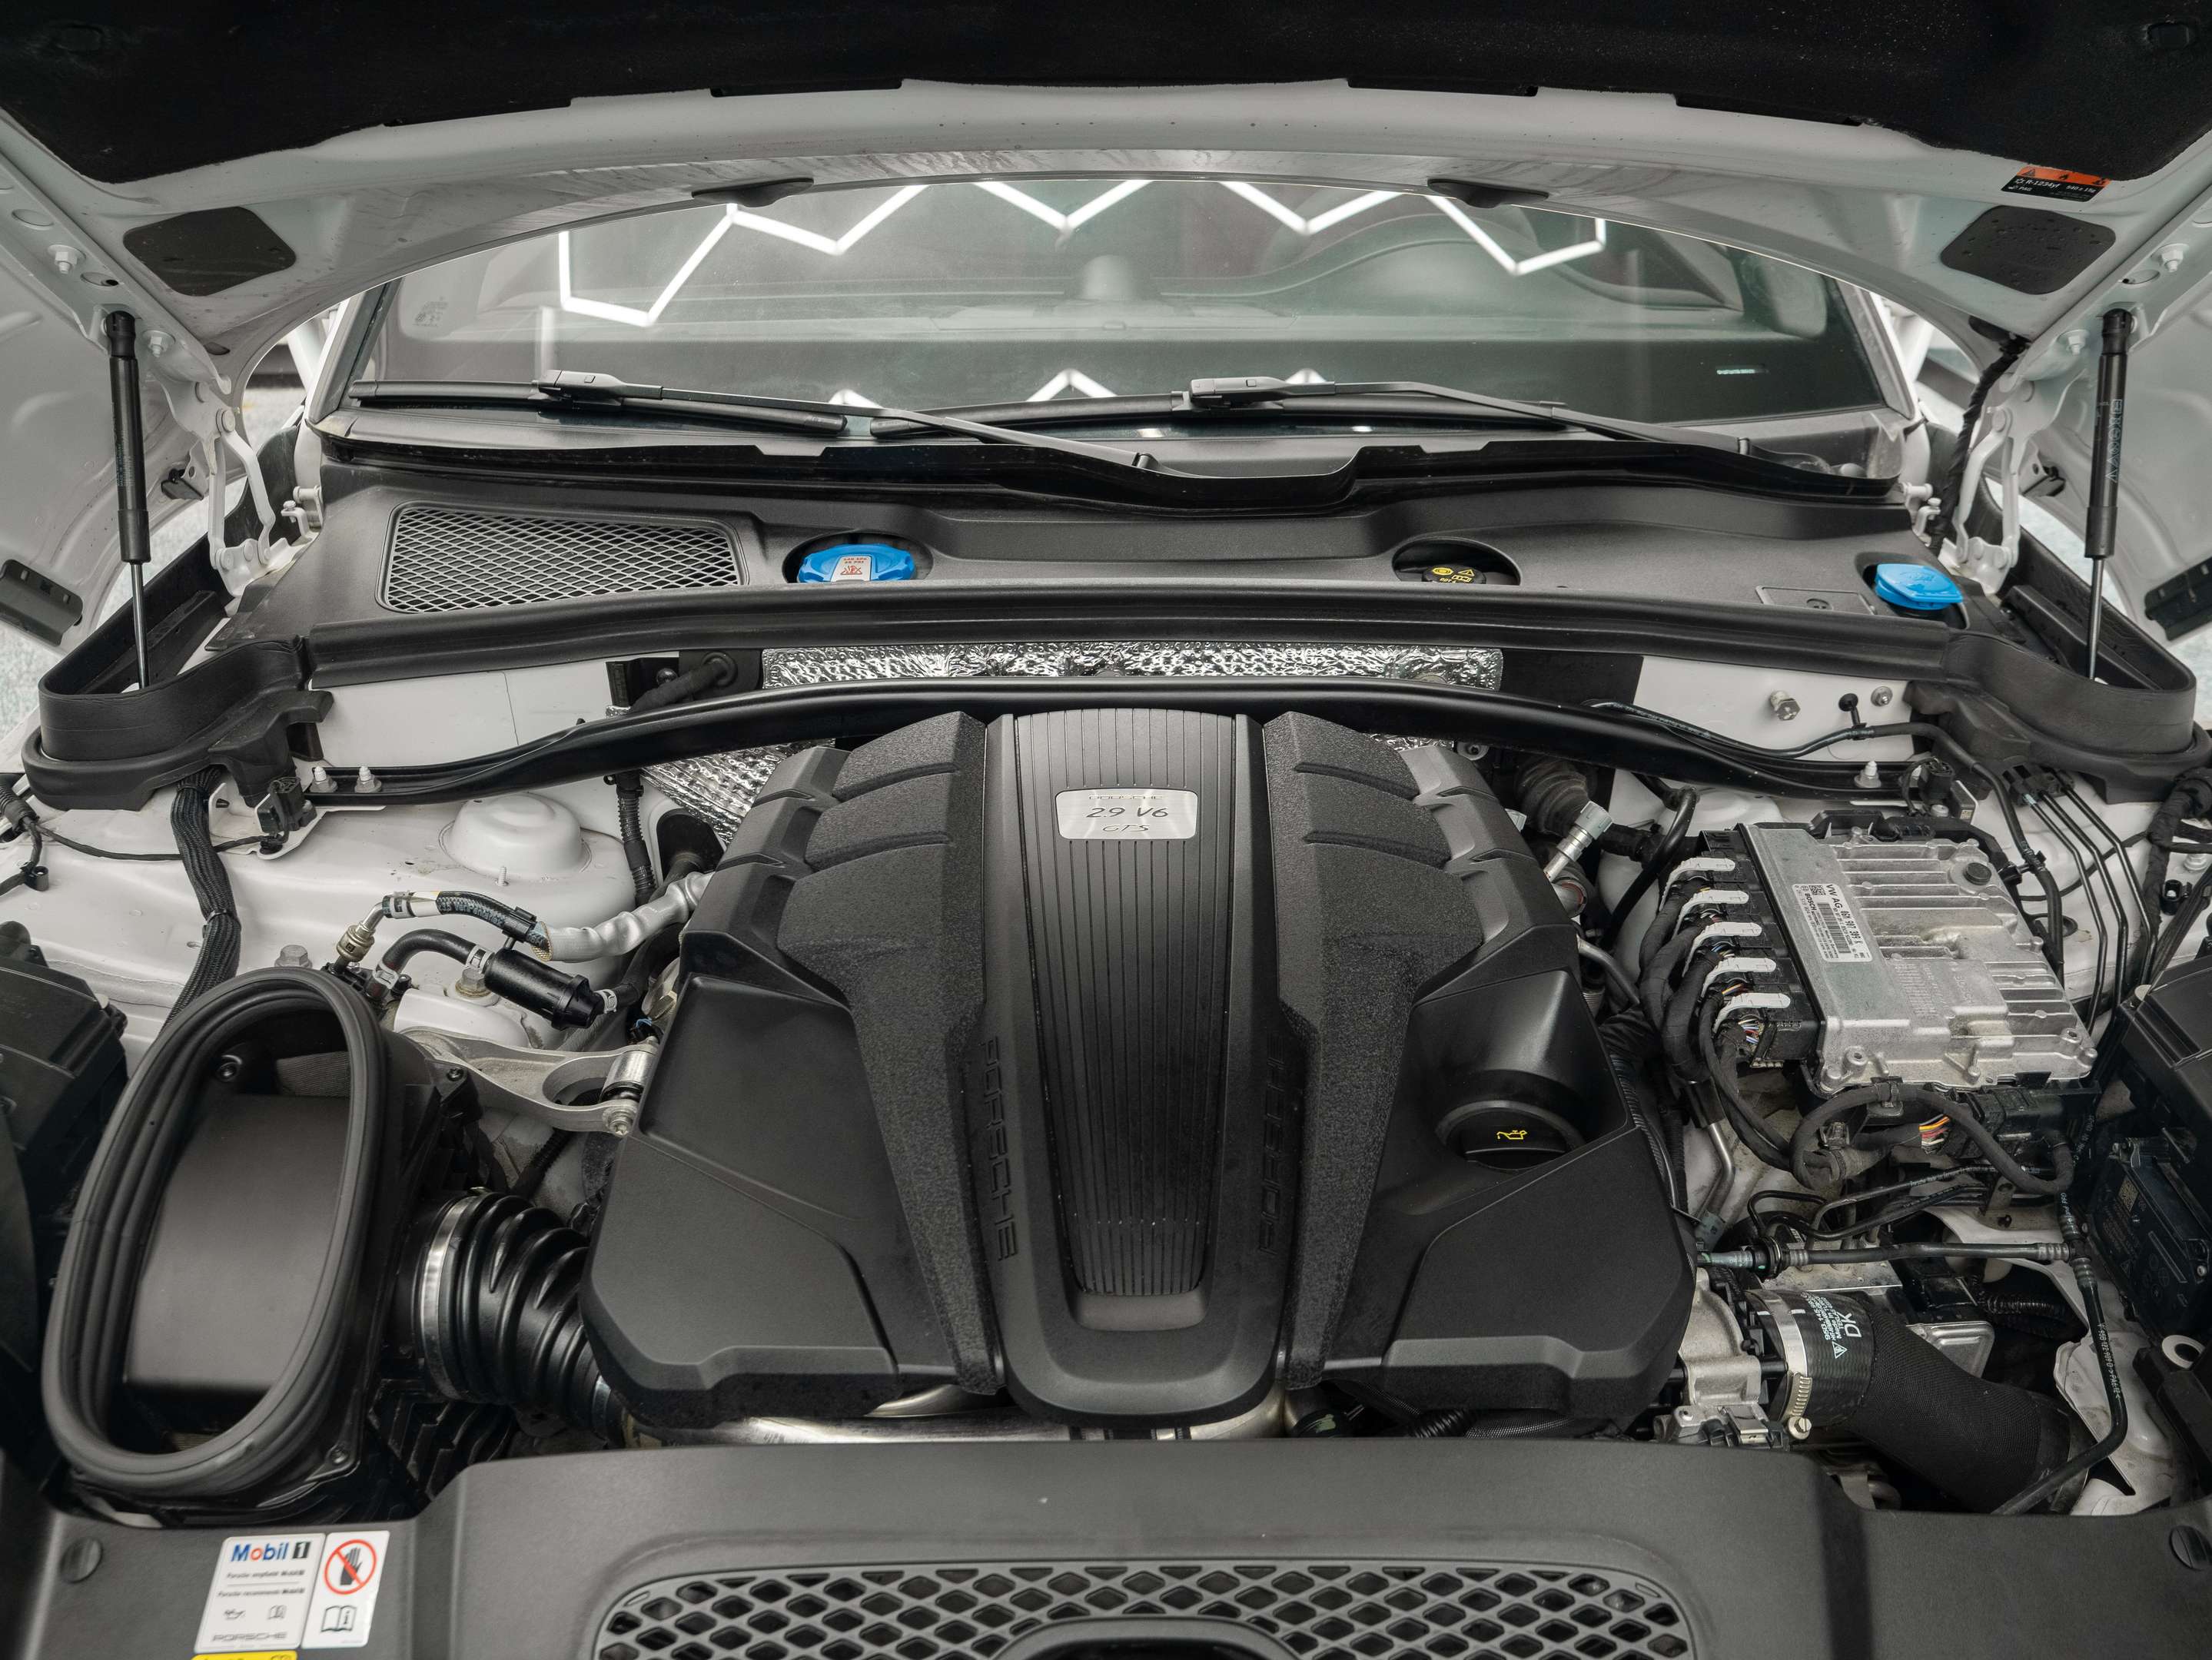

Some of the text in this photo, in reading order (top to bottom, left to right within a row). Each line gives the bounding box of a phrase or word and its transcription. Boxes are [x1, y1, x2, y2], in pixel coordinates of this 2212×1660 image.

[2025, 179, 2061, 189] R-1234yf
[1087, 808, 1168, 818] 2.9 V6
[1805, 893, 1817, 911] BOSCH
[1826, 885, 1838, 896] VW
[1832, 898, 1842, 908] AG
[981, 1037, 1017, 1261] PORSCHE
[1259, 1034, 1285, 1254] PORSCHE
[1836, 1311, 1862, 1337] DK
[231, 1542, 289, 1562] Mobil
[212, 1631, 287, 1642] PORSCHE
